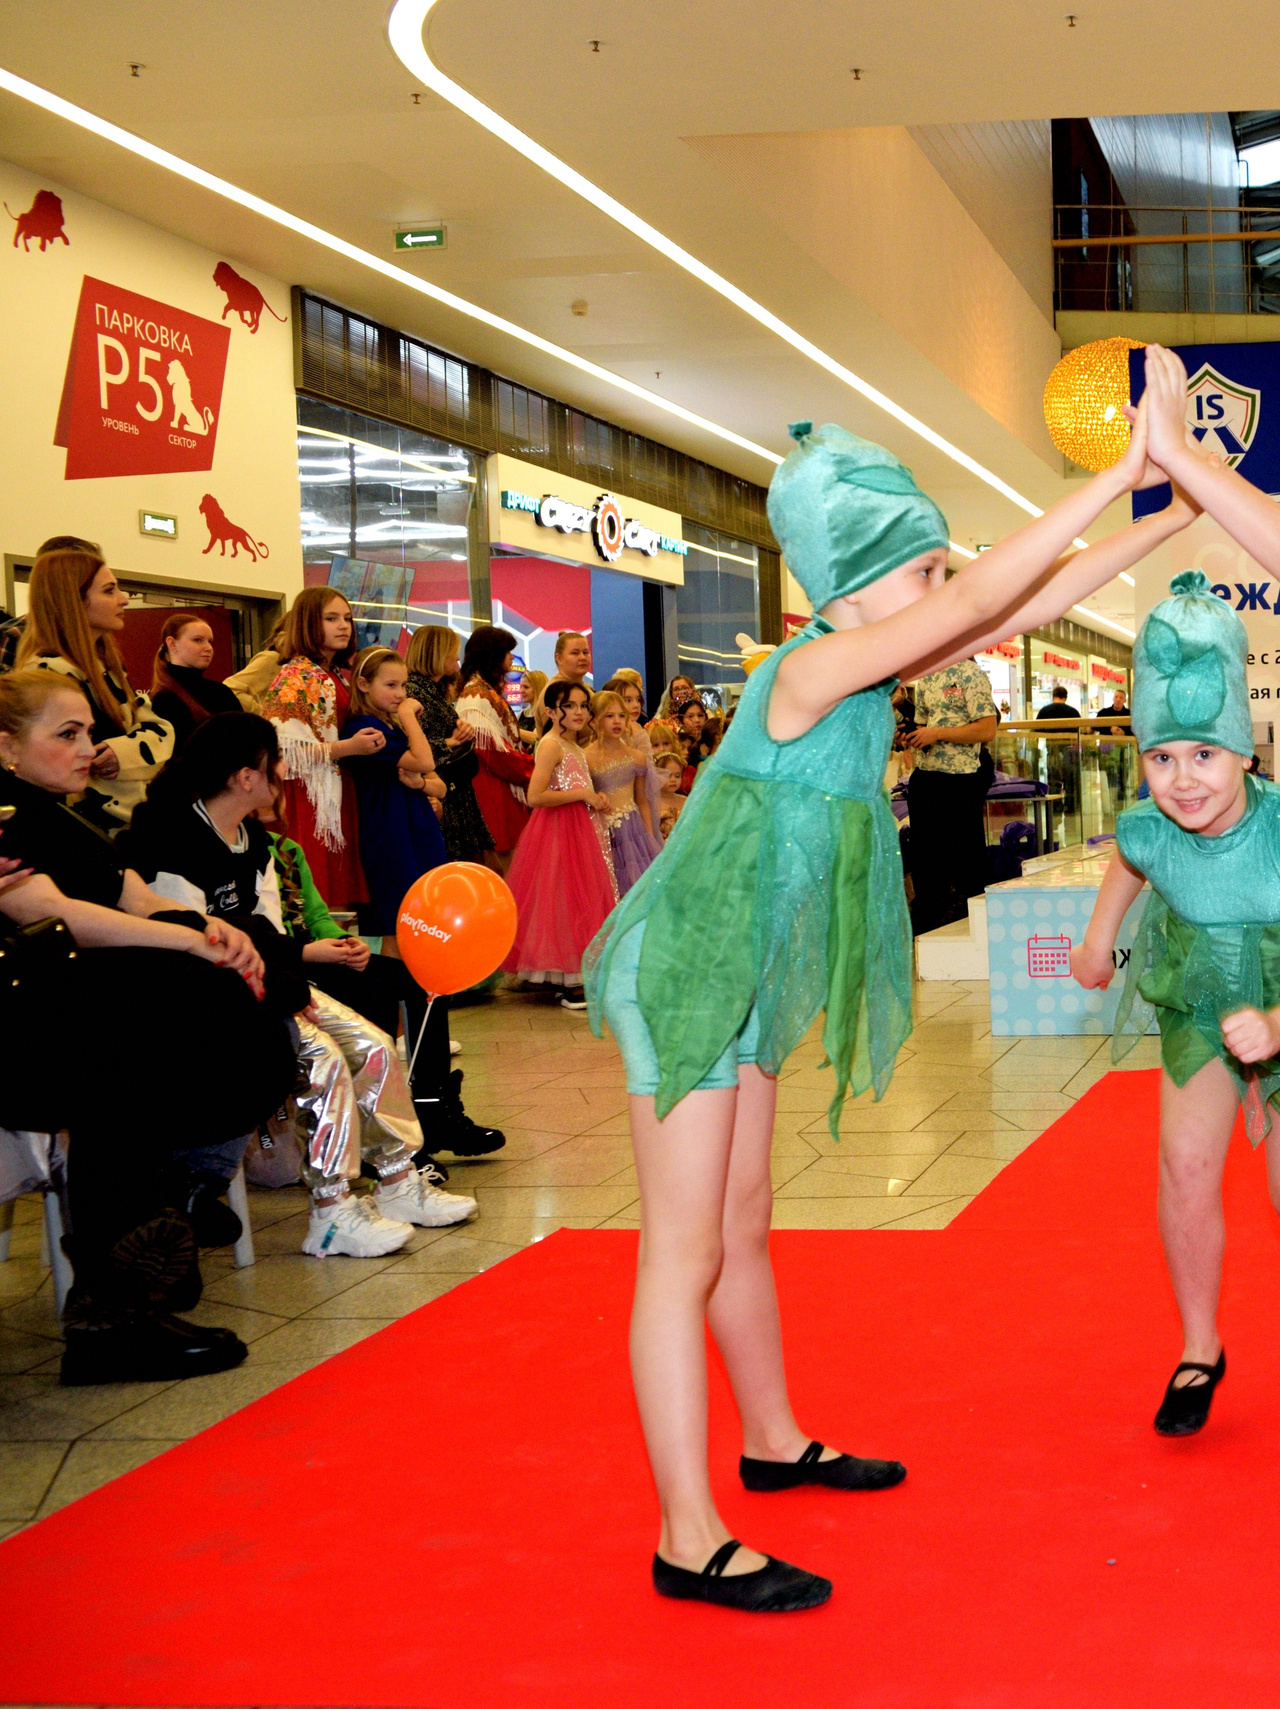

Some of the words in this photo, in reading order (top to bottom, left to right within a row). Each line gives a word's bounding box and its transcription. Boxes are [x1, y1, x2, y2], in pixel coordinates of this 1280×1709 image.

[95, 302, 194, 357] ПАРКОВКА
[1195, 393, 1225, 421] IS
[101, 416, 140, 436] УРОВЕНЬ
[168, 433, 197, 449] СЕКТОР
